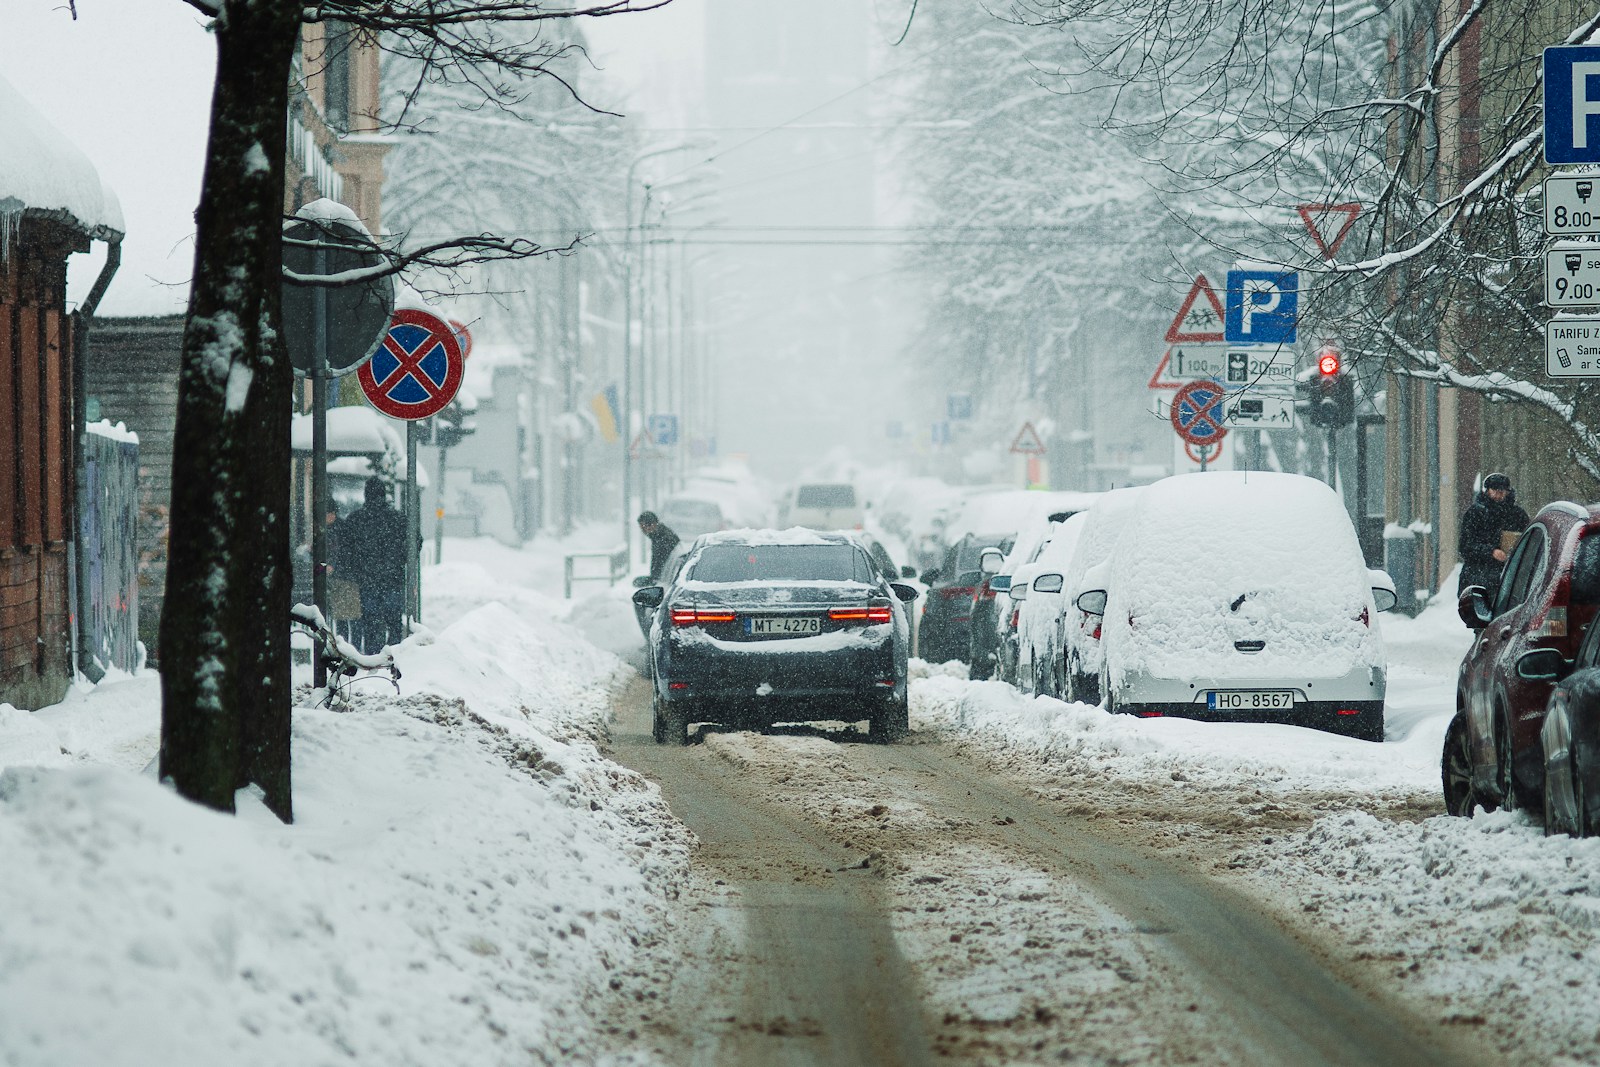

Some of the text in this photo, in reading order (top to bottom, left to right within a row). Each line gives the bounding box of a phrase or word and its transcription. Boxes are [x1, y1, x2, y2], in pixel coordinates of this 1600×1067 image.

[1241, 279, 1281, 334] P
[1553, 328, 1590, 339] TARIFU
[1577, 344, 1600, 355] Sam
[1188, 360, 1207, 371] 100
[1580, 361, 1591, 369] ar
[754, 619, 818, 632] MT-4278
[1219, 693, 1290, 708] HO-8567
